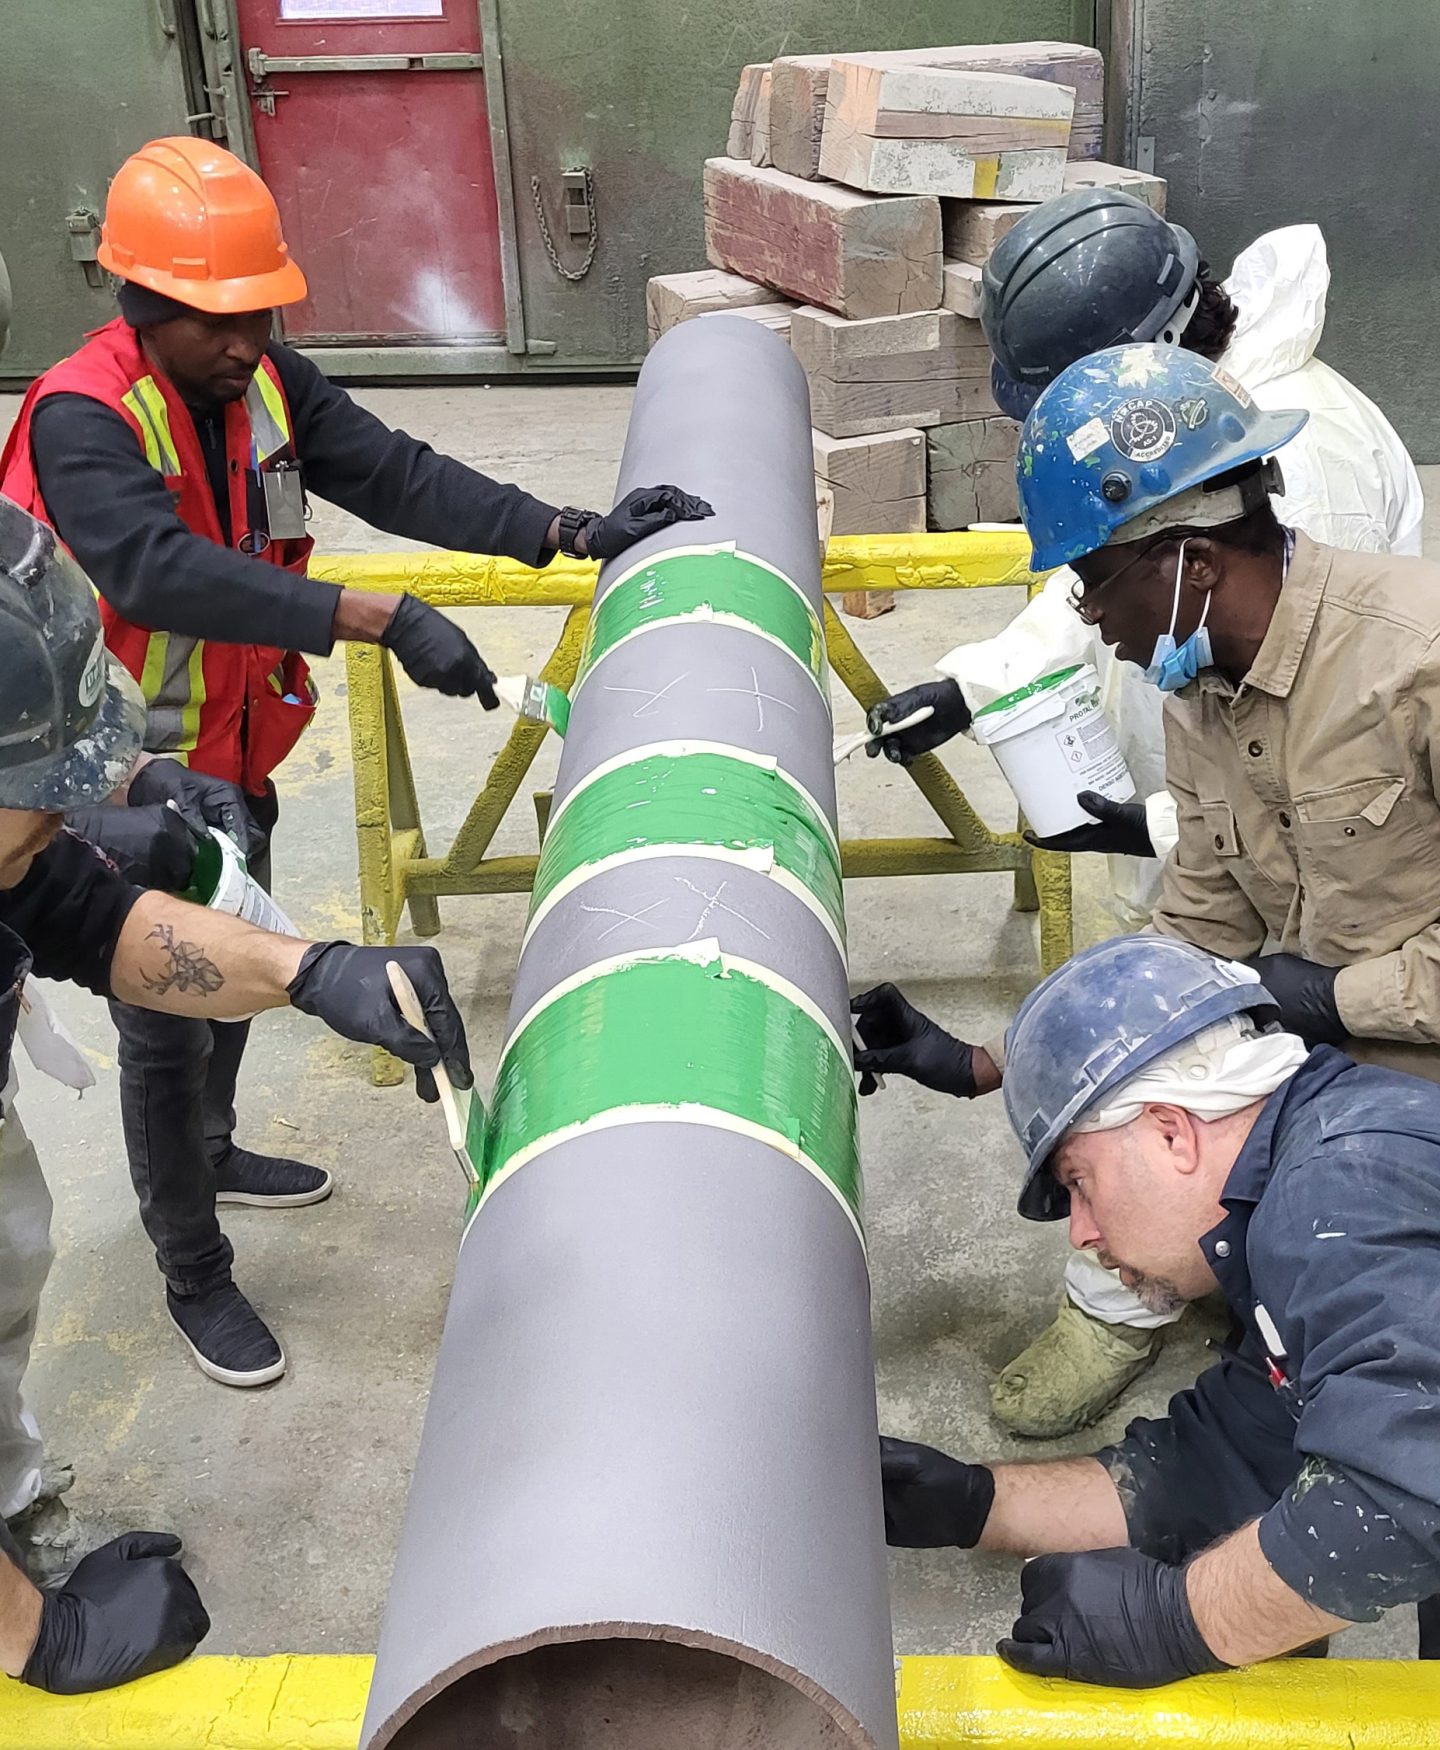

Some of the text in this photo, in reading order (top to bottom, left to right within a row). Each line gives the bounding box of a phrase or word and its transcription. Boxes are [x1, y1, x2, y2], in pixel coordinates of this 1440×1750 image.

[1135, 435, 1171, 459] ACCREDITED
[1143, 435, 1157, 447] AS-1
[1069, 705, 1093, 723] PROTAL
